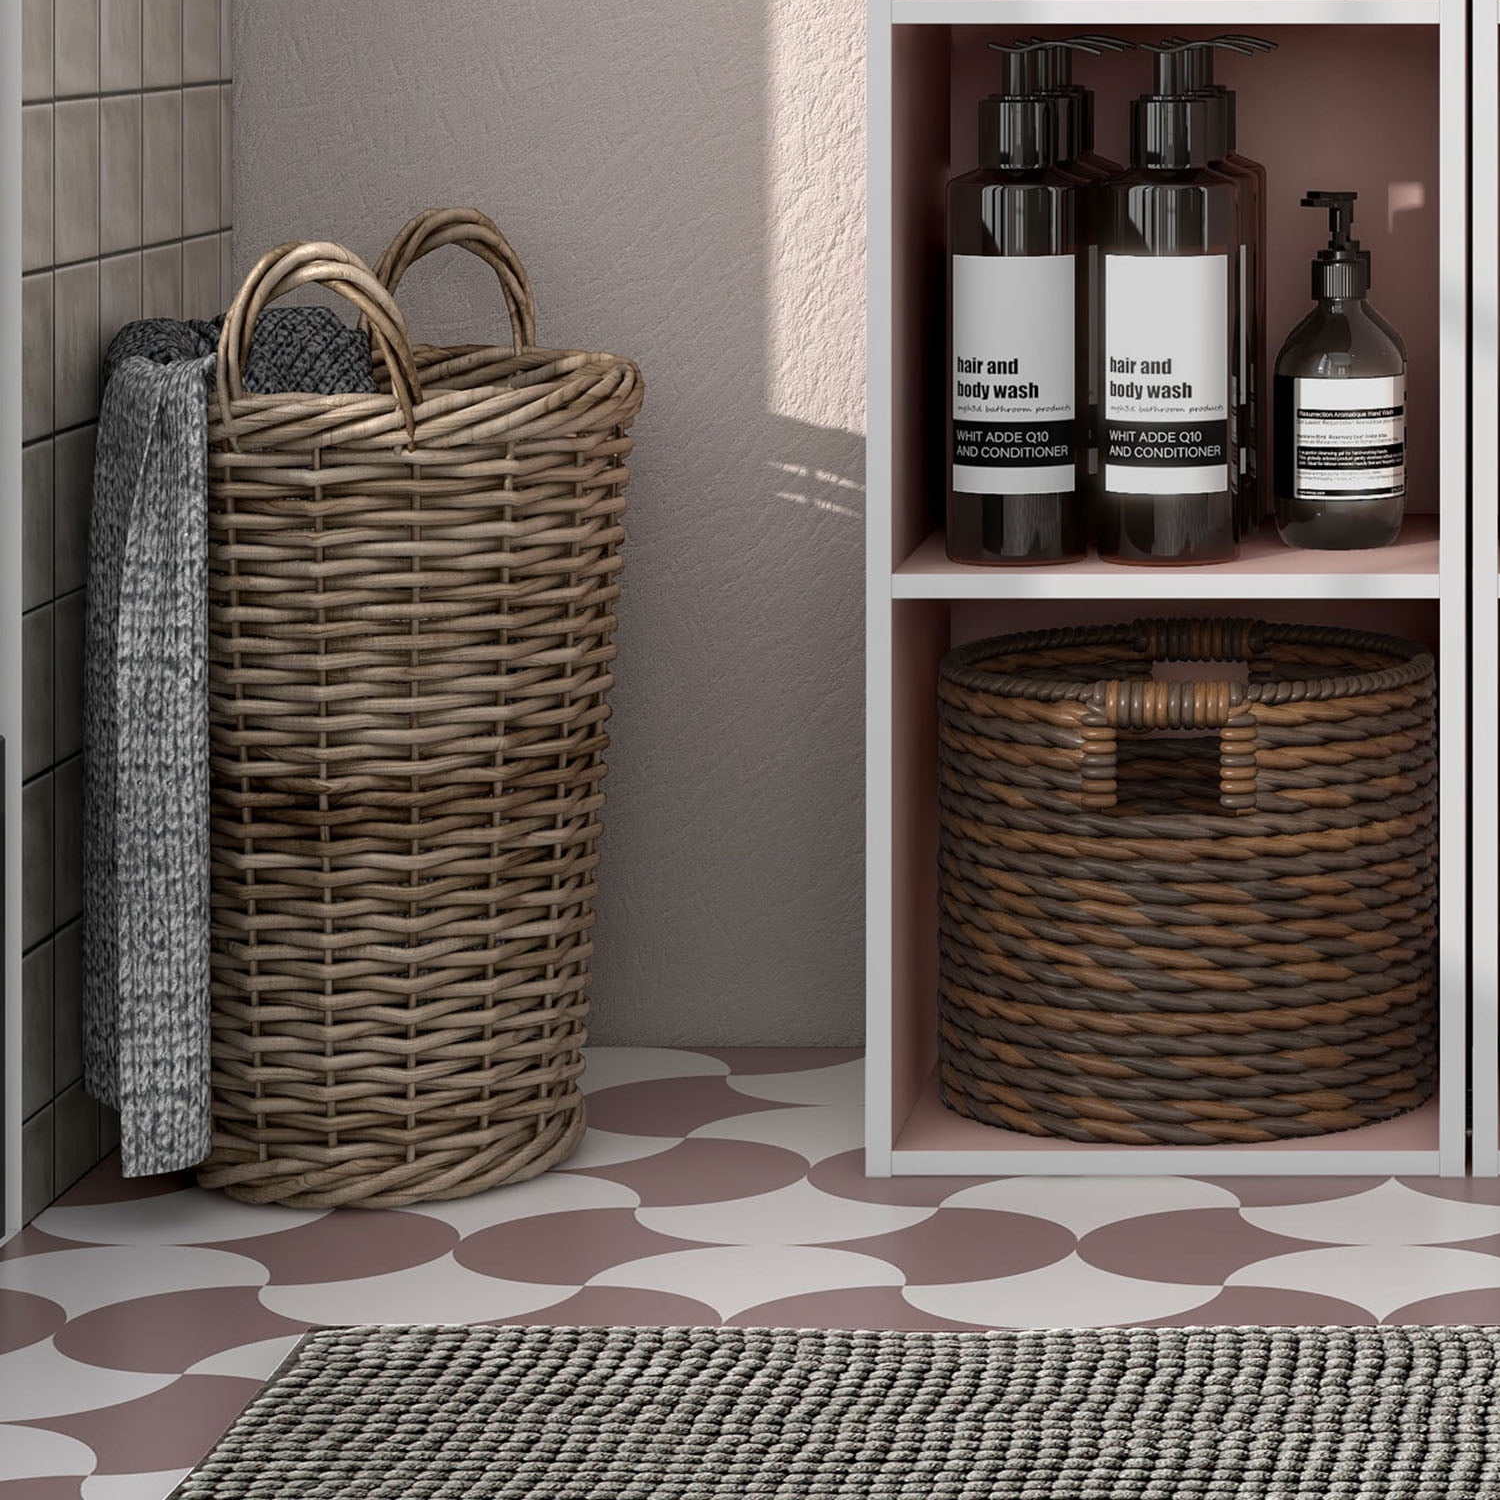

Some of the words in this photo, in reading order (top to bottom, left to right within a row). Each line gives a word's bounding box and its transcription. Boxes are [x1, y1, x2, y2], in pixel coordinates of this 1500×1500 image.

[957, 356, 983, 374] hair
[987, 358, 1019, 375] and
[1110, 356, 1137, 374] hair
[1140, 358, 1172, 375] and
[957, 380, 990, 400] body
[993, 382, 1039, 399] wash
[1110, 380, 1143, 400] body
[1147, 382, 1192, 399] wash
[956, 429, 983, 442] WHIT
[985, 431, 1023, 443] ADDE
[1025, 431, 1049, 444] Q10
[1109, 429, 1136, 442] WHIT
[1138, 431, 1176, 443] ADDE
[1178, 431, 1202, 444] Q10
[956, 445, 979, 457] AND
[981, 445, 1069, 458] CONDITIONER
[1109, 445, 1132, 457] AND
[1134, 445, 1221, 458] CONDITIONER
